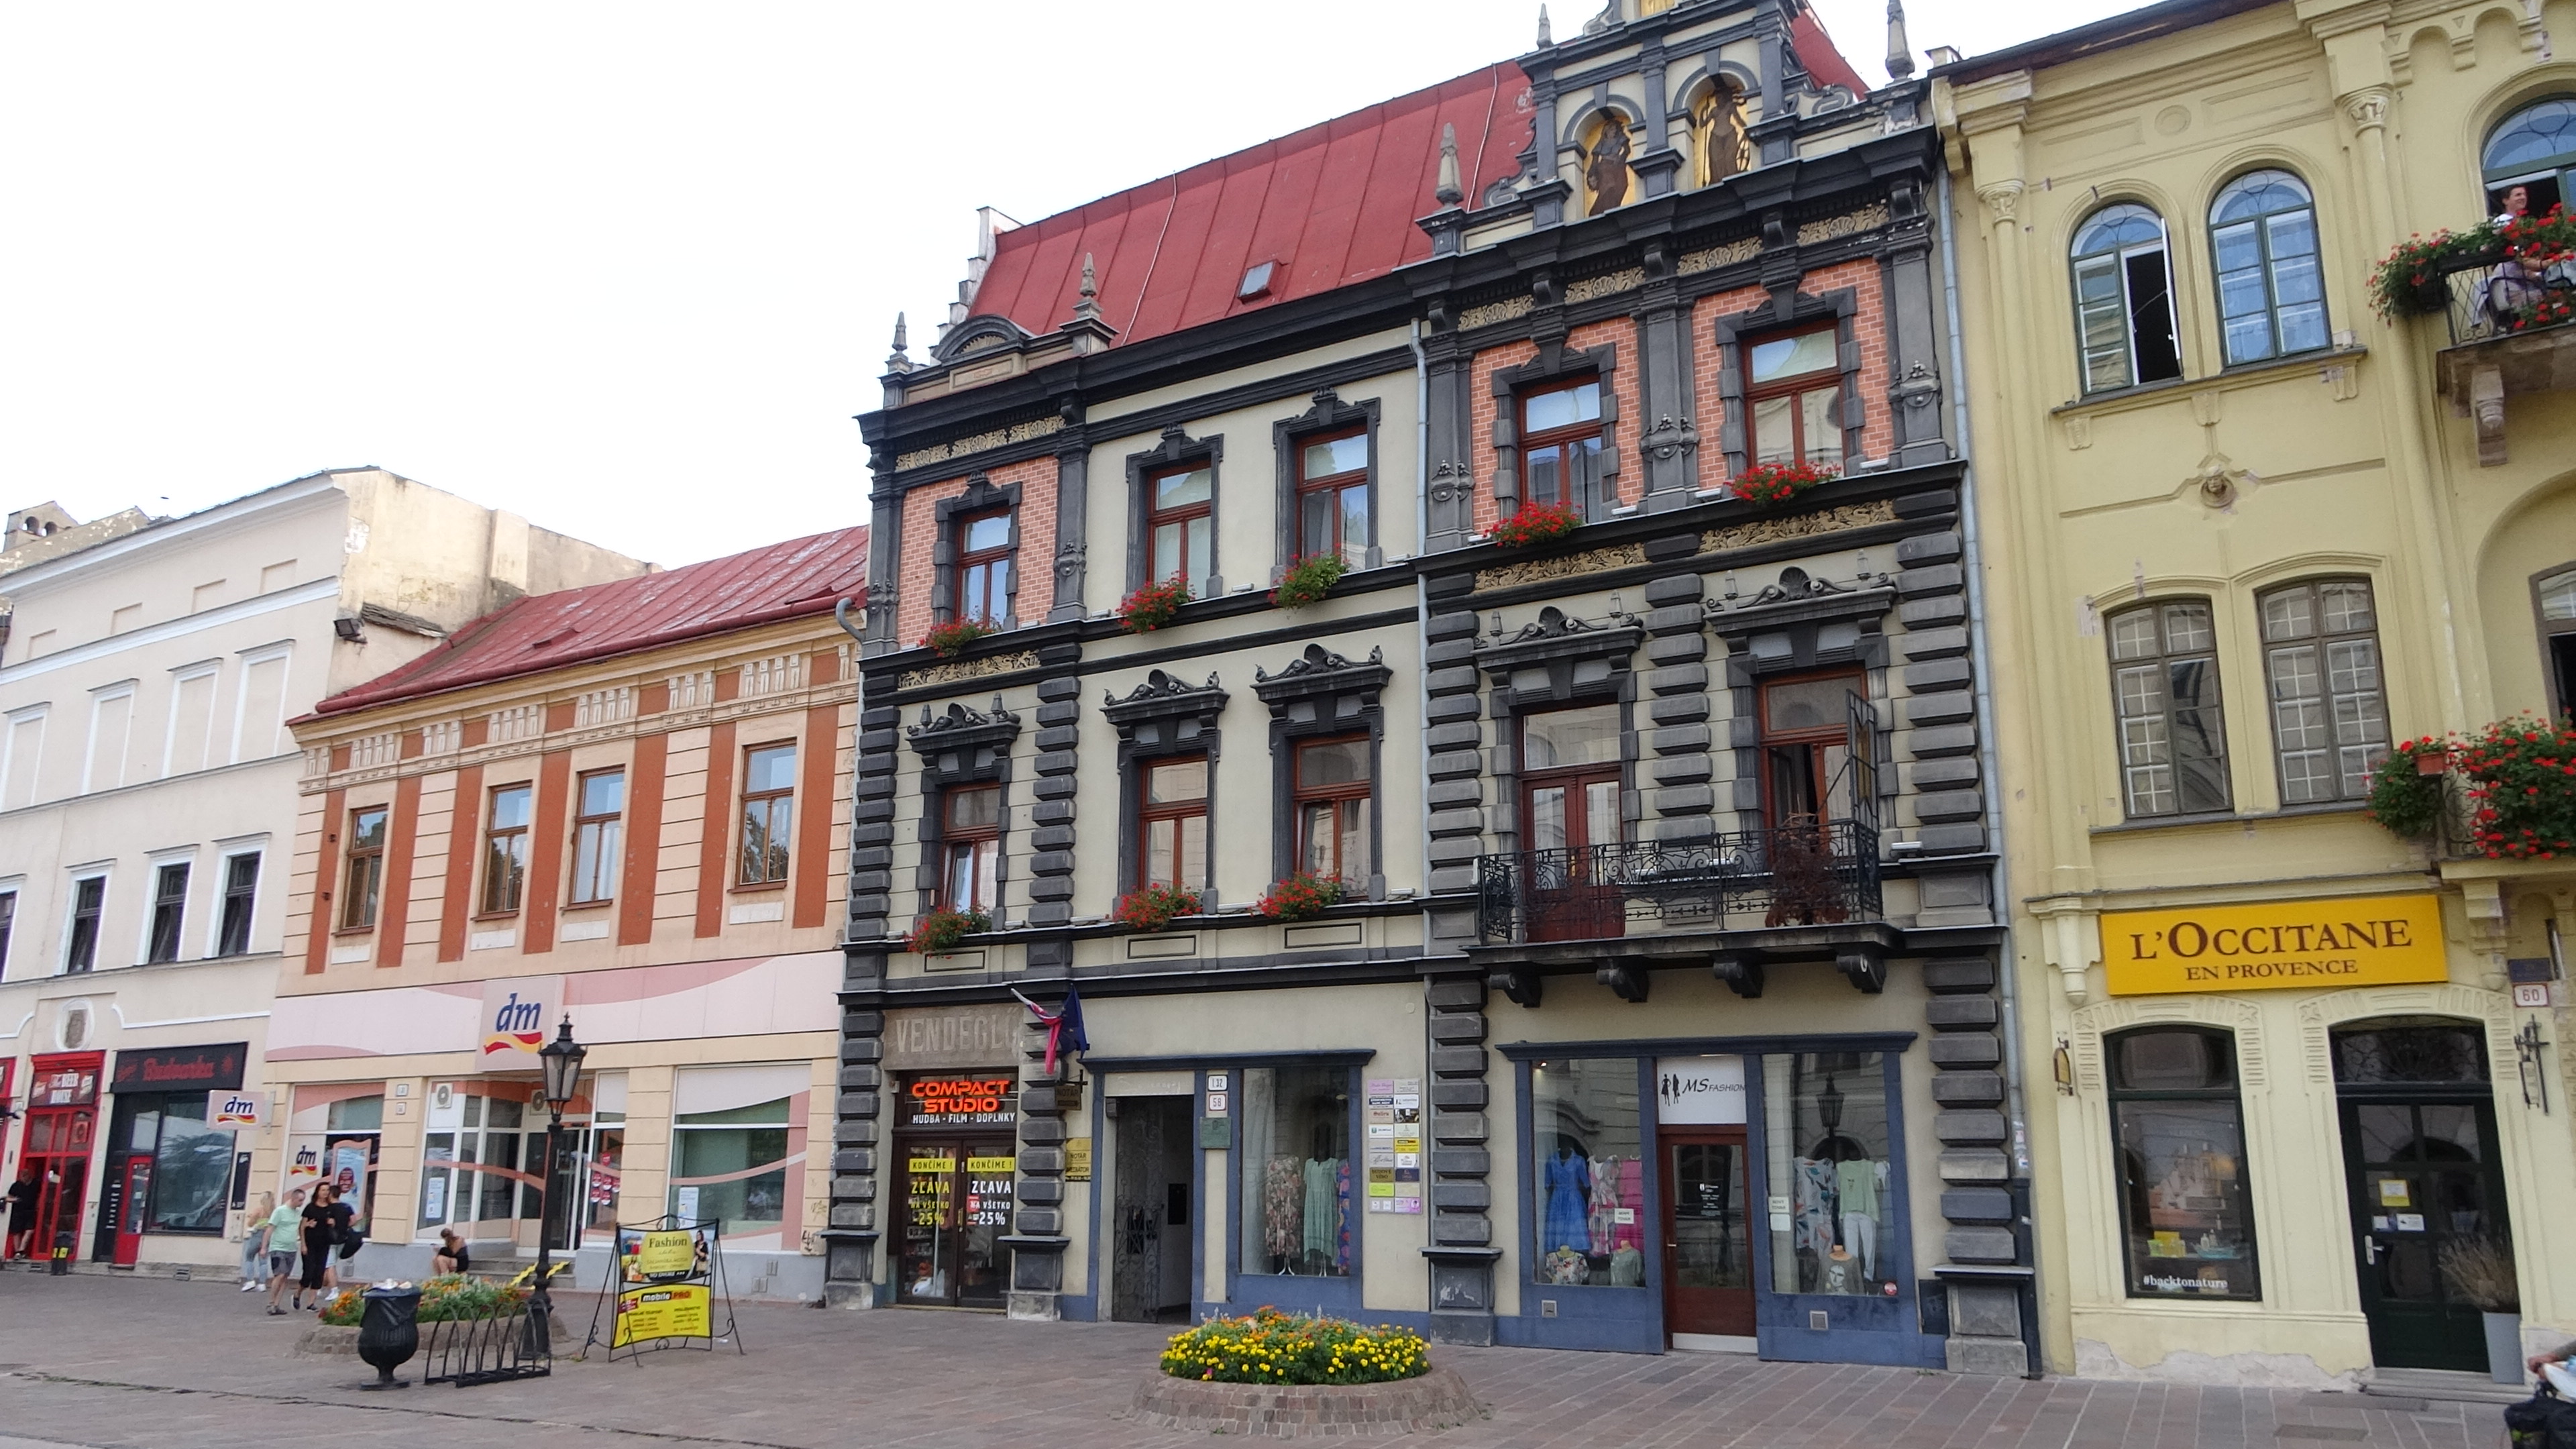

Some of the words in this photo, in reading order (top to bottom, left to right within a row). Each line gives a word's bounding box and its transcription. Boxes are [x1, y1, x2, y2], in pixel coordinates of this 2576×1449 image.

[2130, 919, 2413, 960] L'OCCITANE
[2186, 965, 2219, 981] EN
[2226, 959, 2359, 979] PROVENCE
[2522, 989, 2539, 1002] 60
[496, 992, 542, 1032] dm
[911, 1079, 1010, 1097] COMPACT
[1682, 1078, 1709, 1094] MS
[1709, 1083, 1745, 1092] FASHION
[224, 1096, 254, 1114] dm
[923, 1097, 1000, 1114] STUDIO
[1213, 1097, 1222, 1107] 58
[912, 1114, 941, 1124] HUDBA
[948, 1114, 967, 1124] FILM
[976, 1112, 1016, 1123] DOPLNKY
[296, 1145, 317, 1165] dm
[913, 1160, 946, 1169] KONČÍME
[971, 1159, 1005, 1169] KONČÍME
[911, 1181, 950, 1194] ZĽAVA
[971, 1181, 1012, 1194] ZĽAVA
[923, 1198, 949, 1209] VŠETKO
[970, 1201, 980, 1209] NA
[983, 1199, 1010, 1210] VŠETKO
[649, 1236, 688, 1248] Fashion
[2143, 1274, 2228, 1288] #backtonature
